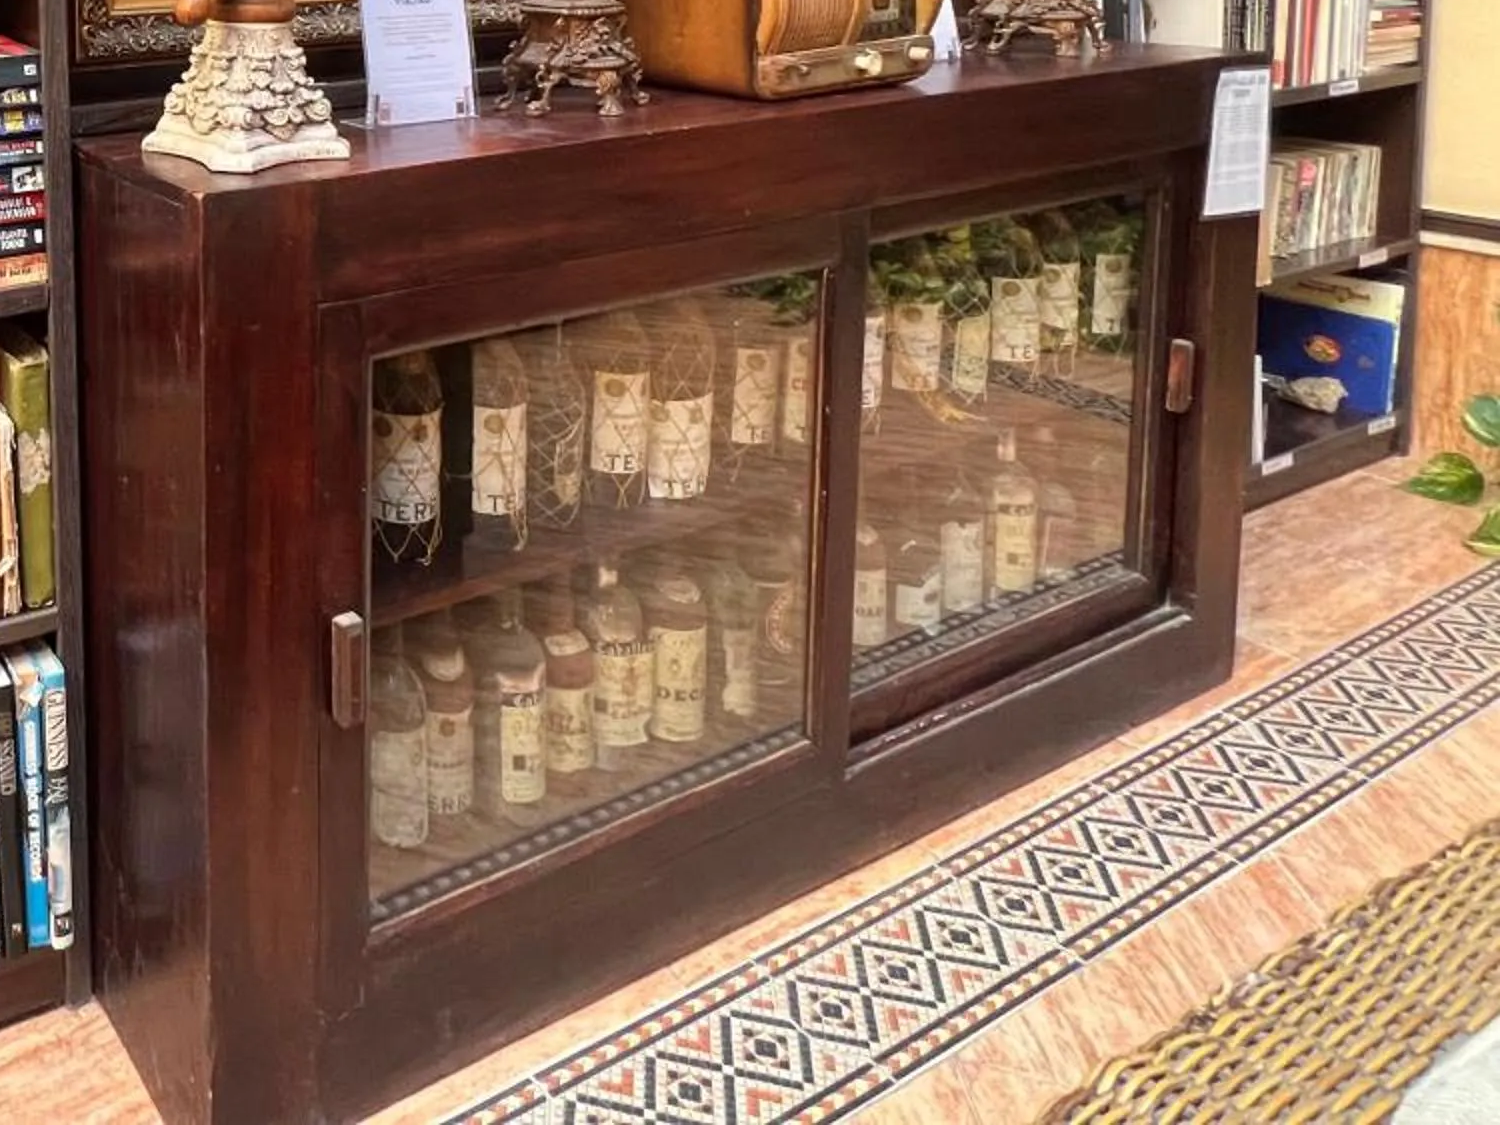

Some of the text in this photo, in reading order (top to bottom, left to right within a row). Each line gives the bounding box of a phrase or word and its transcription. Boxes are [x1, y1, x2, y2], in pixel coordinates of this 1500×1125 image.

[25, 720, 43, 882] GUINNESS BOOK OF RECORDS
